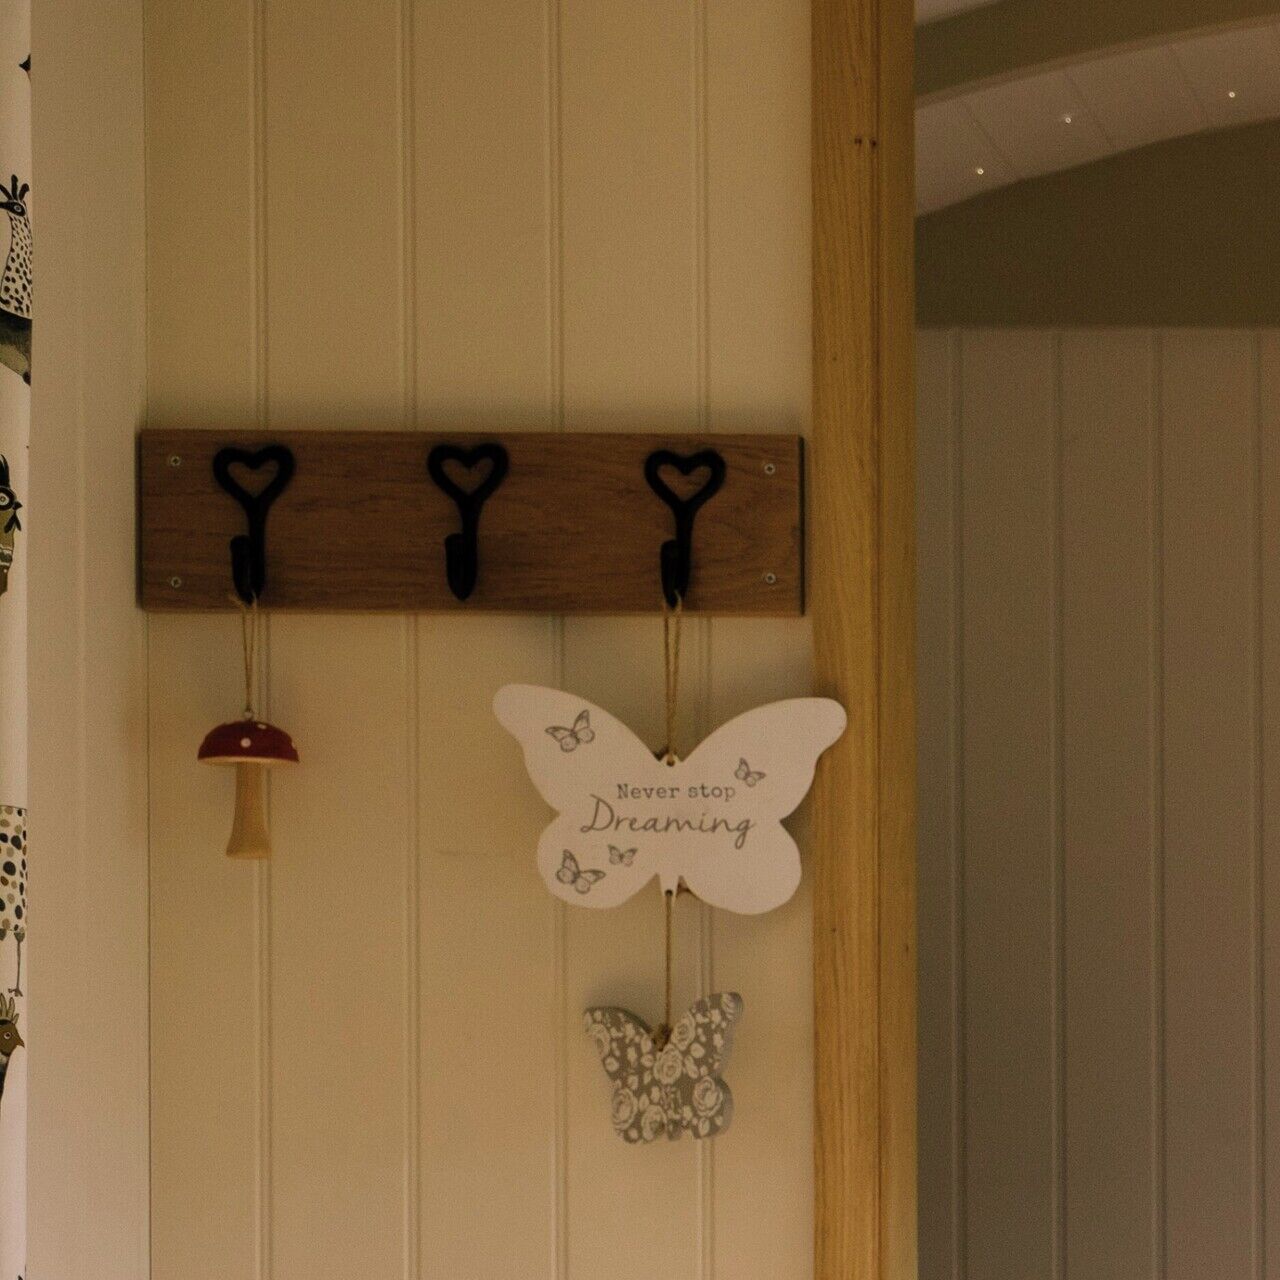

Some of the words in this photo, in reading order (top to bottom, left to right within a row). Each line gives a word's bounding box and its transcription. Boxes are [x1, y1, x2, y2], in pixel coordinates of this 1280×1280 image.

[616, 783, 680, 800] Never
[688, 783, 737, 802] stop
[580, 793, 757, 850] Dreaming
